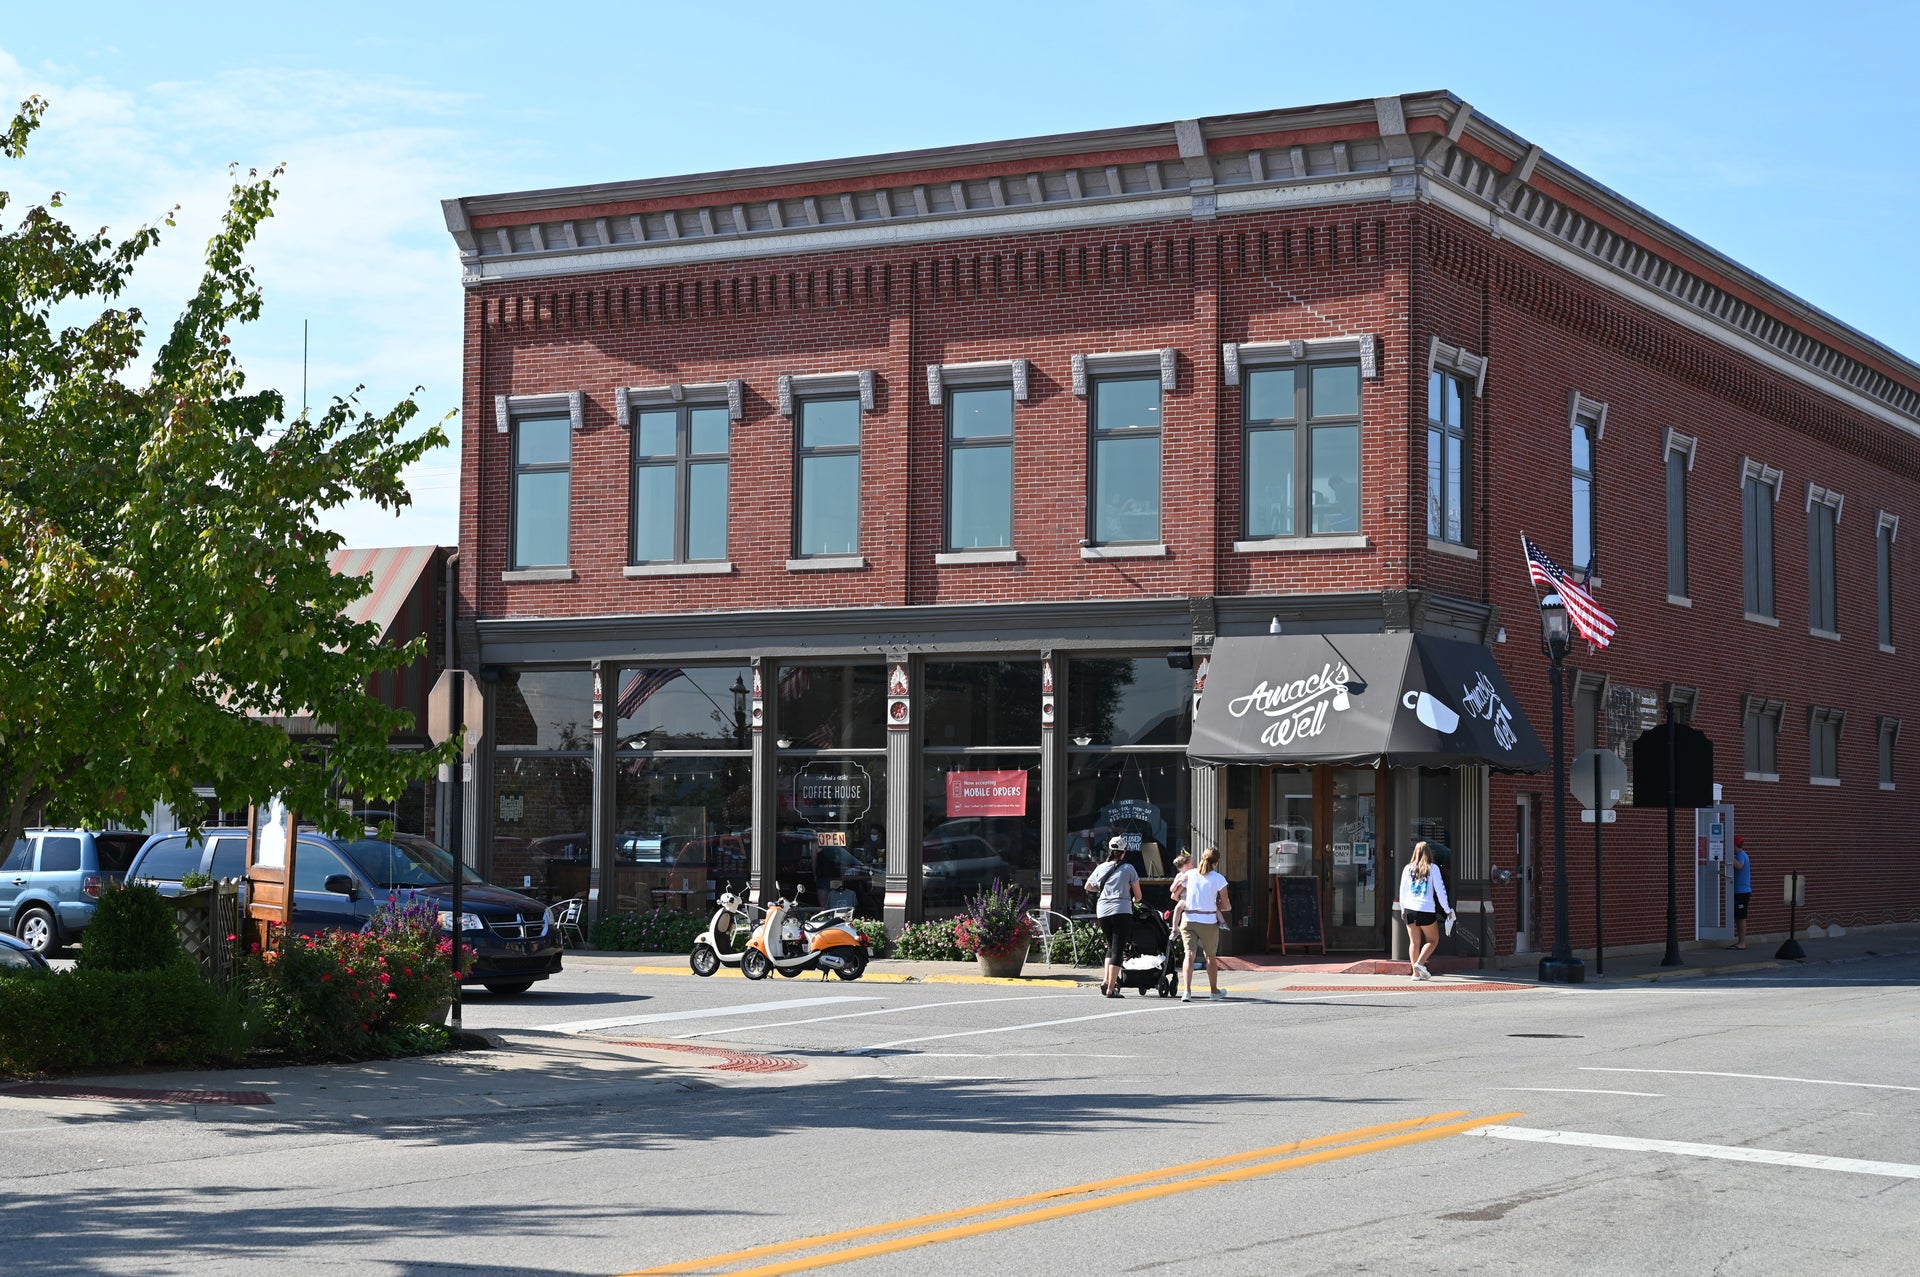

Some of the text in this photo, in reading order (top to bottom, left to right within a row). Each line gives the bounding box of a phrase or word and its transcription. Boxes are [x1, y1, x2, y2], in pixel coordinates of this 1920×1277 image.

[1228, 661, 1350, 718] Amack's
[1260, 699, 1330, 747] Well
[803, 785, 861, 799] COFFEE HOUSE
[963, 786, 1021, 798] MOBILE ORDERS
[818, 833, 846, 846] OPEN
